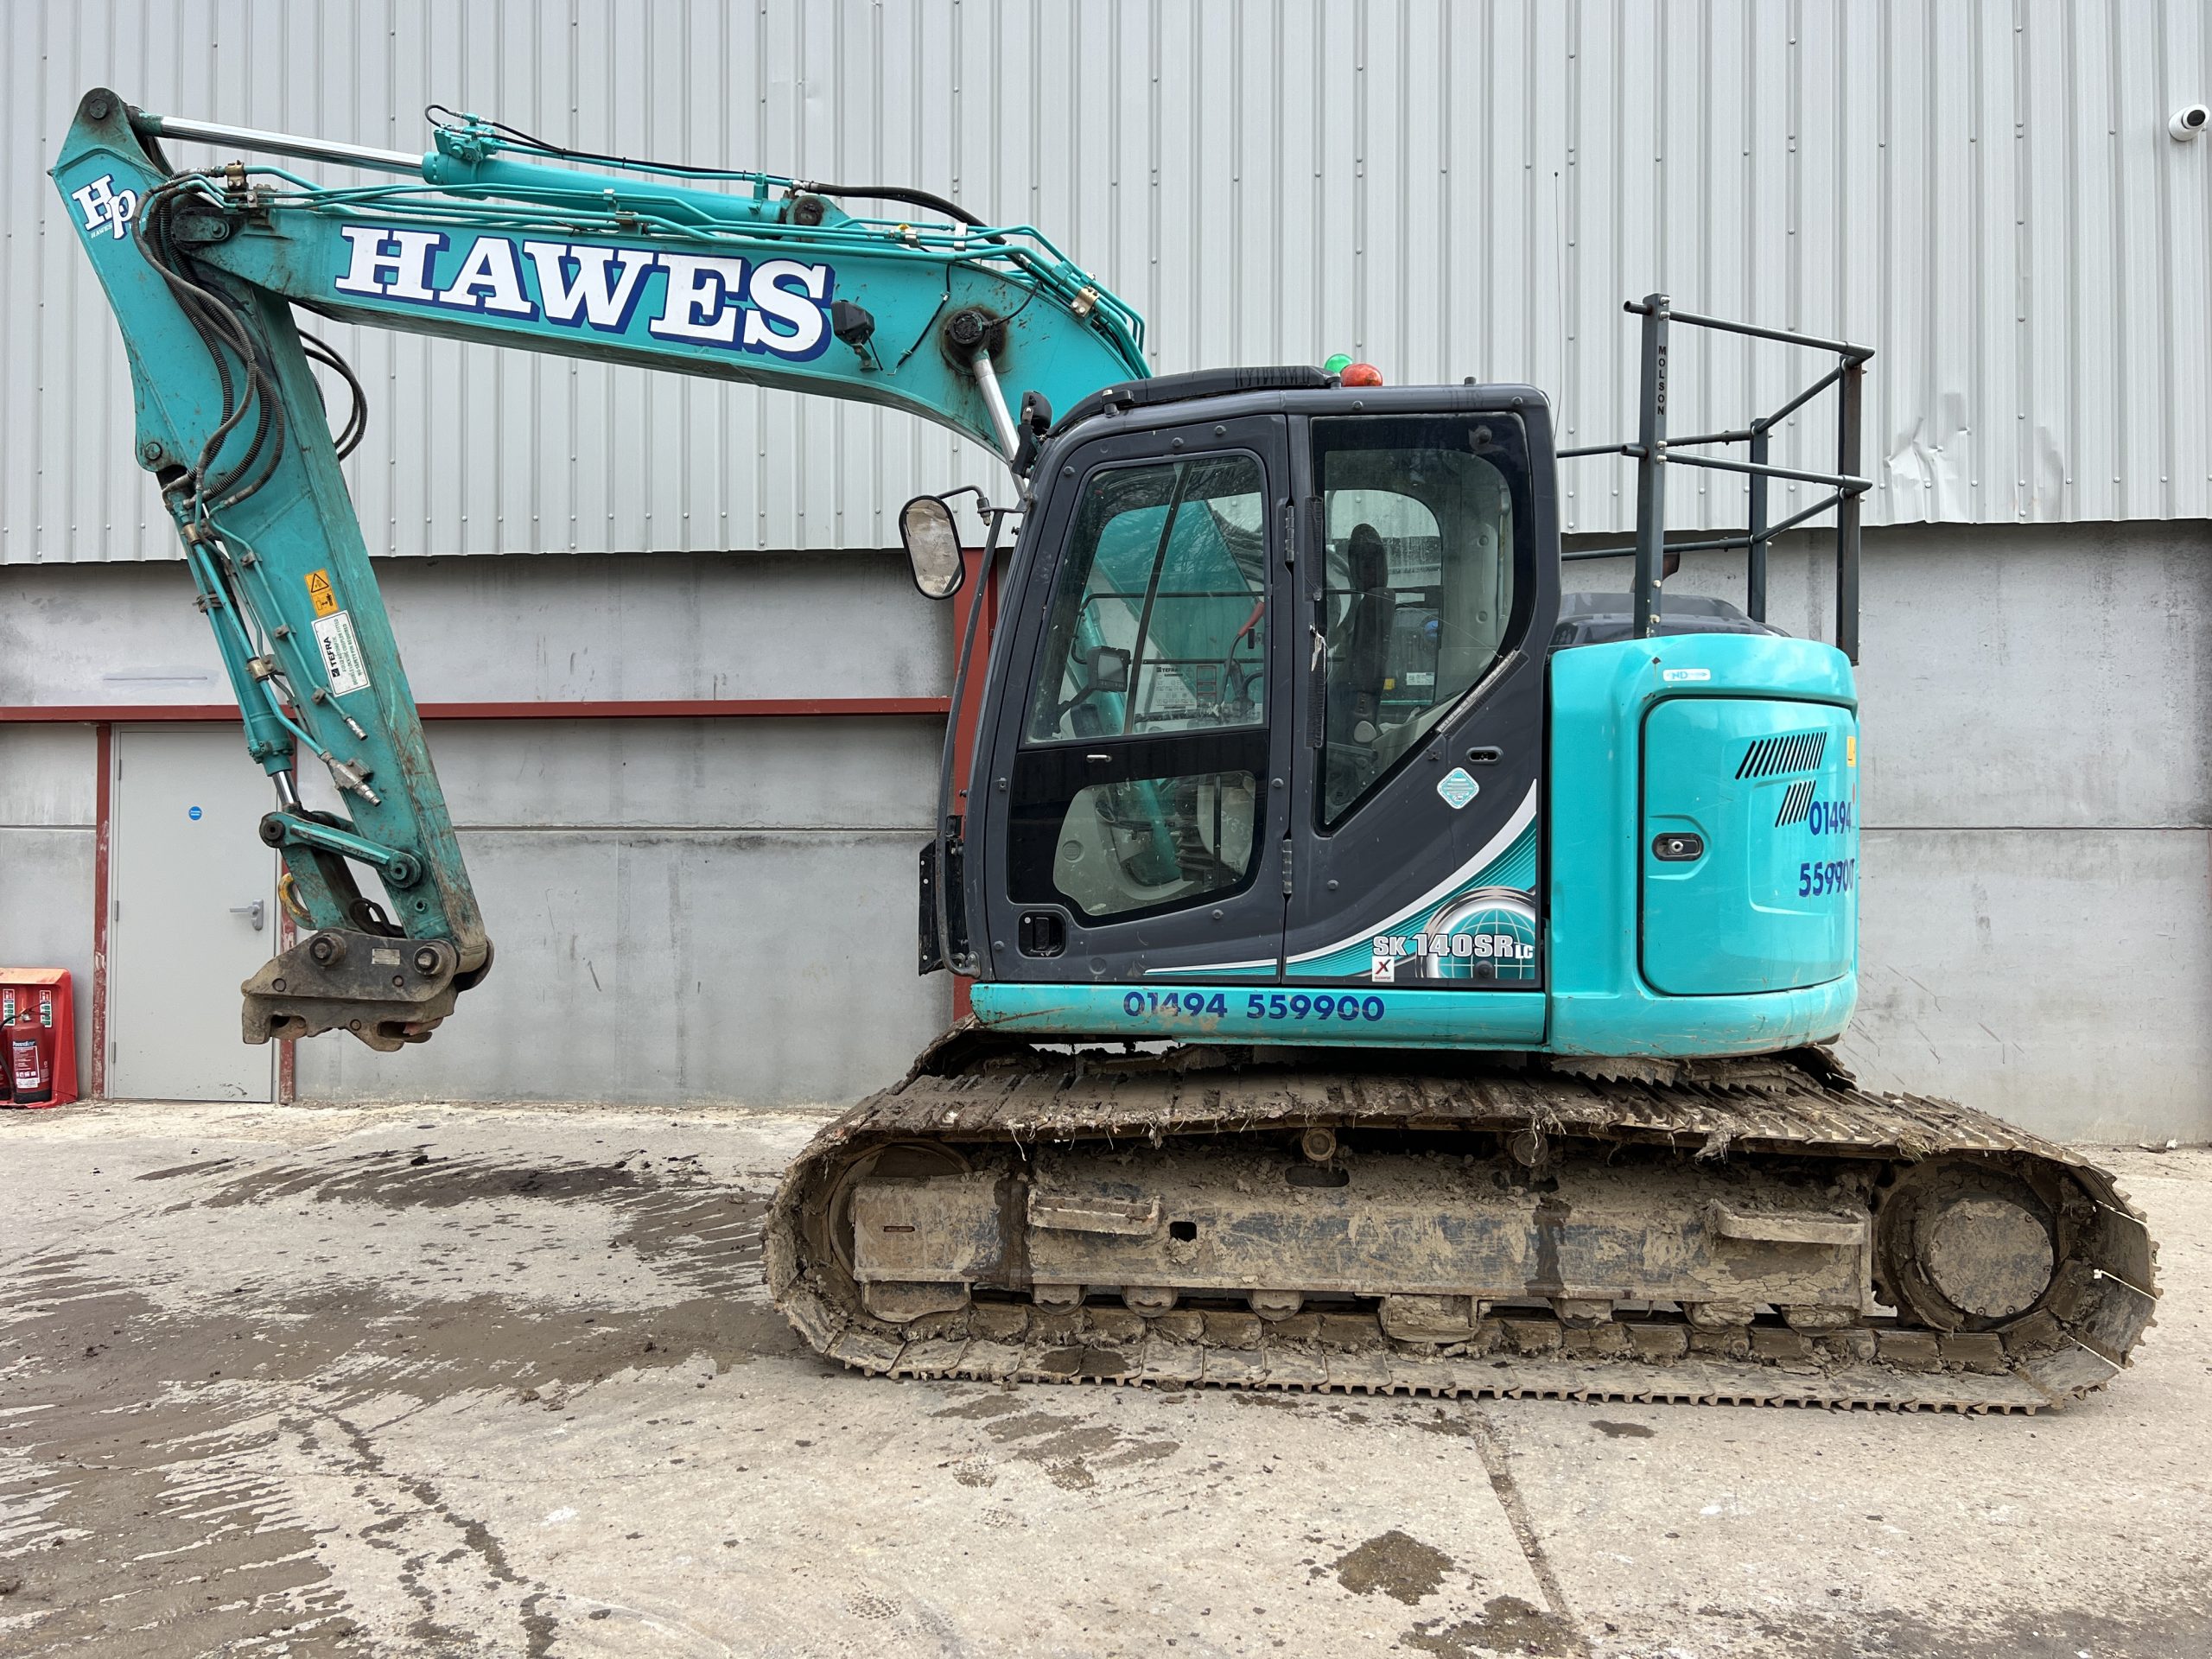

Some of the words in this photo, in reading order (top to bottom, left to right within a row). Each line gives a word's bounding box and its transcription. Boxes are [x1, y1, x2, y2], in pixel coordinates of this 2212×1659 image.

[334, 224, 836, 362] HAWES
[1656, 345, 1667, 416] MOLSON
[338, 632, 347, 652] COUPLER
[342, 623, 353, 645] REQUIRED
[323, 637, 337, 667] TEFRA
[332, 636, 342, 659] AUTOMATIC
[343, 652, 353, 670] LOCKING
[352, 653, 360, 670] SAFETY
[349, 670, 359, 685] DOUBLE
[1809, 800, 1851, 836] 01494
[1372, 935, 1408, 957] SK
[1411, 933, 1515, 957] 140SR
[1123, 991, 1228, 1018] 01494
[1247, 994, 1385, 1021] 559900
